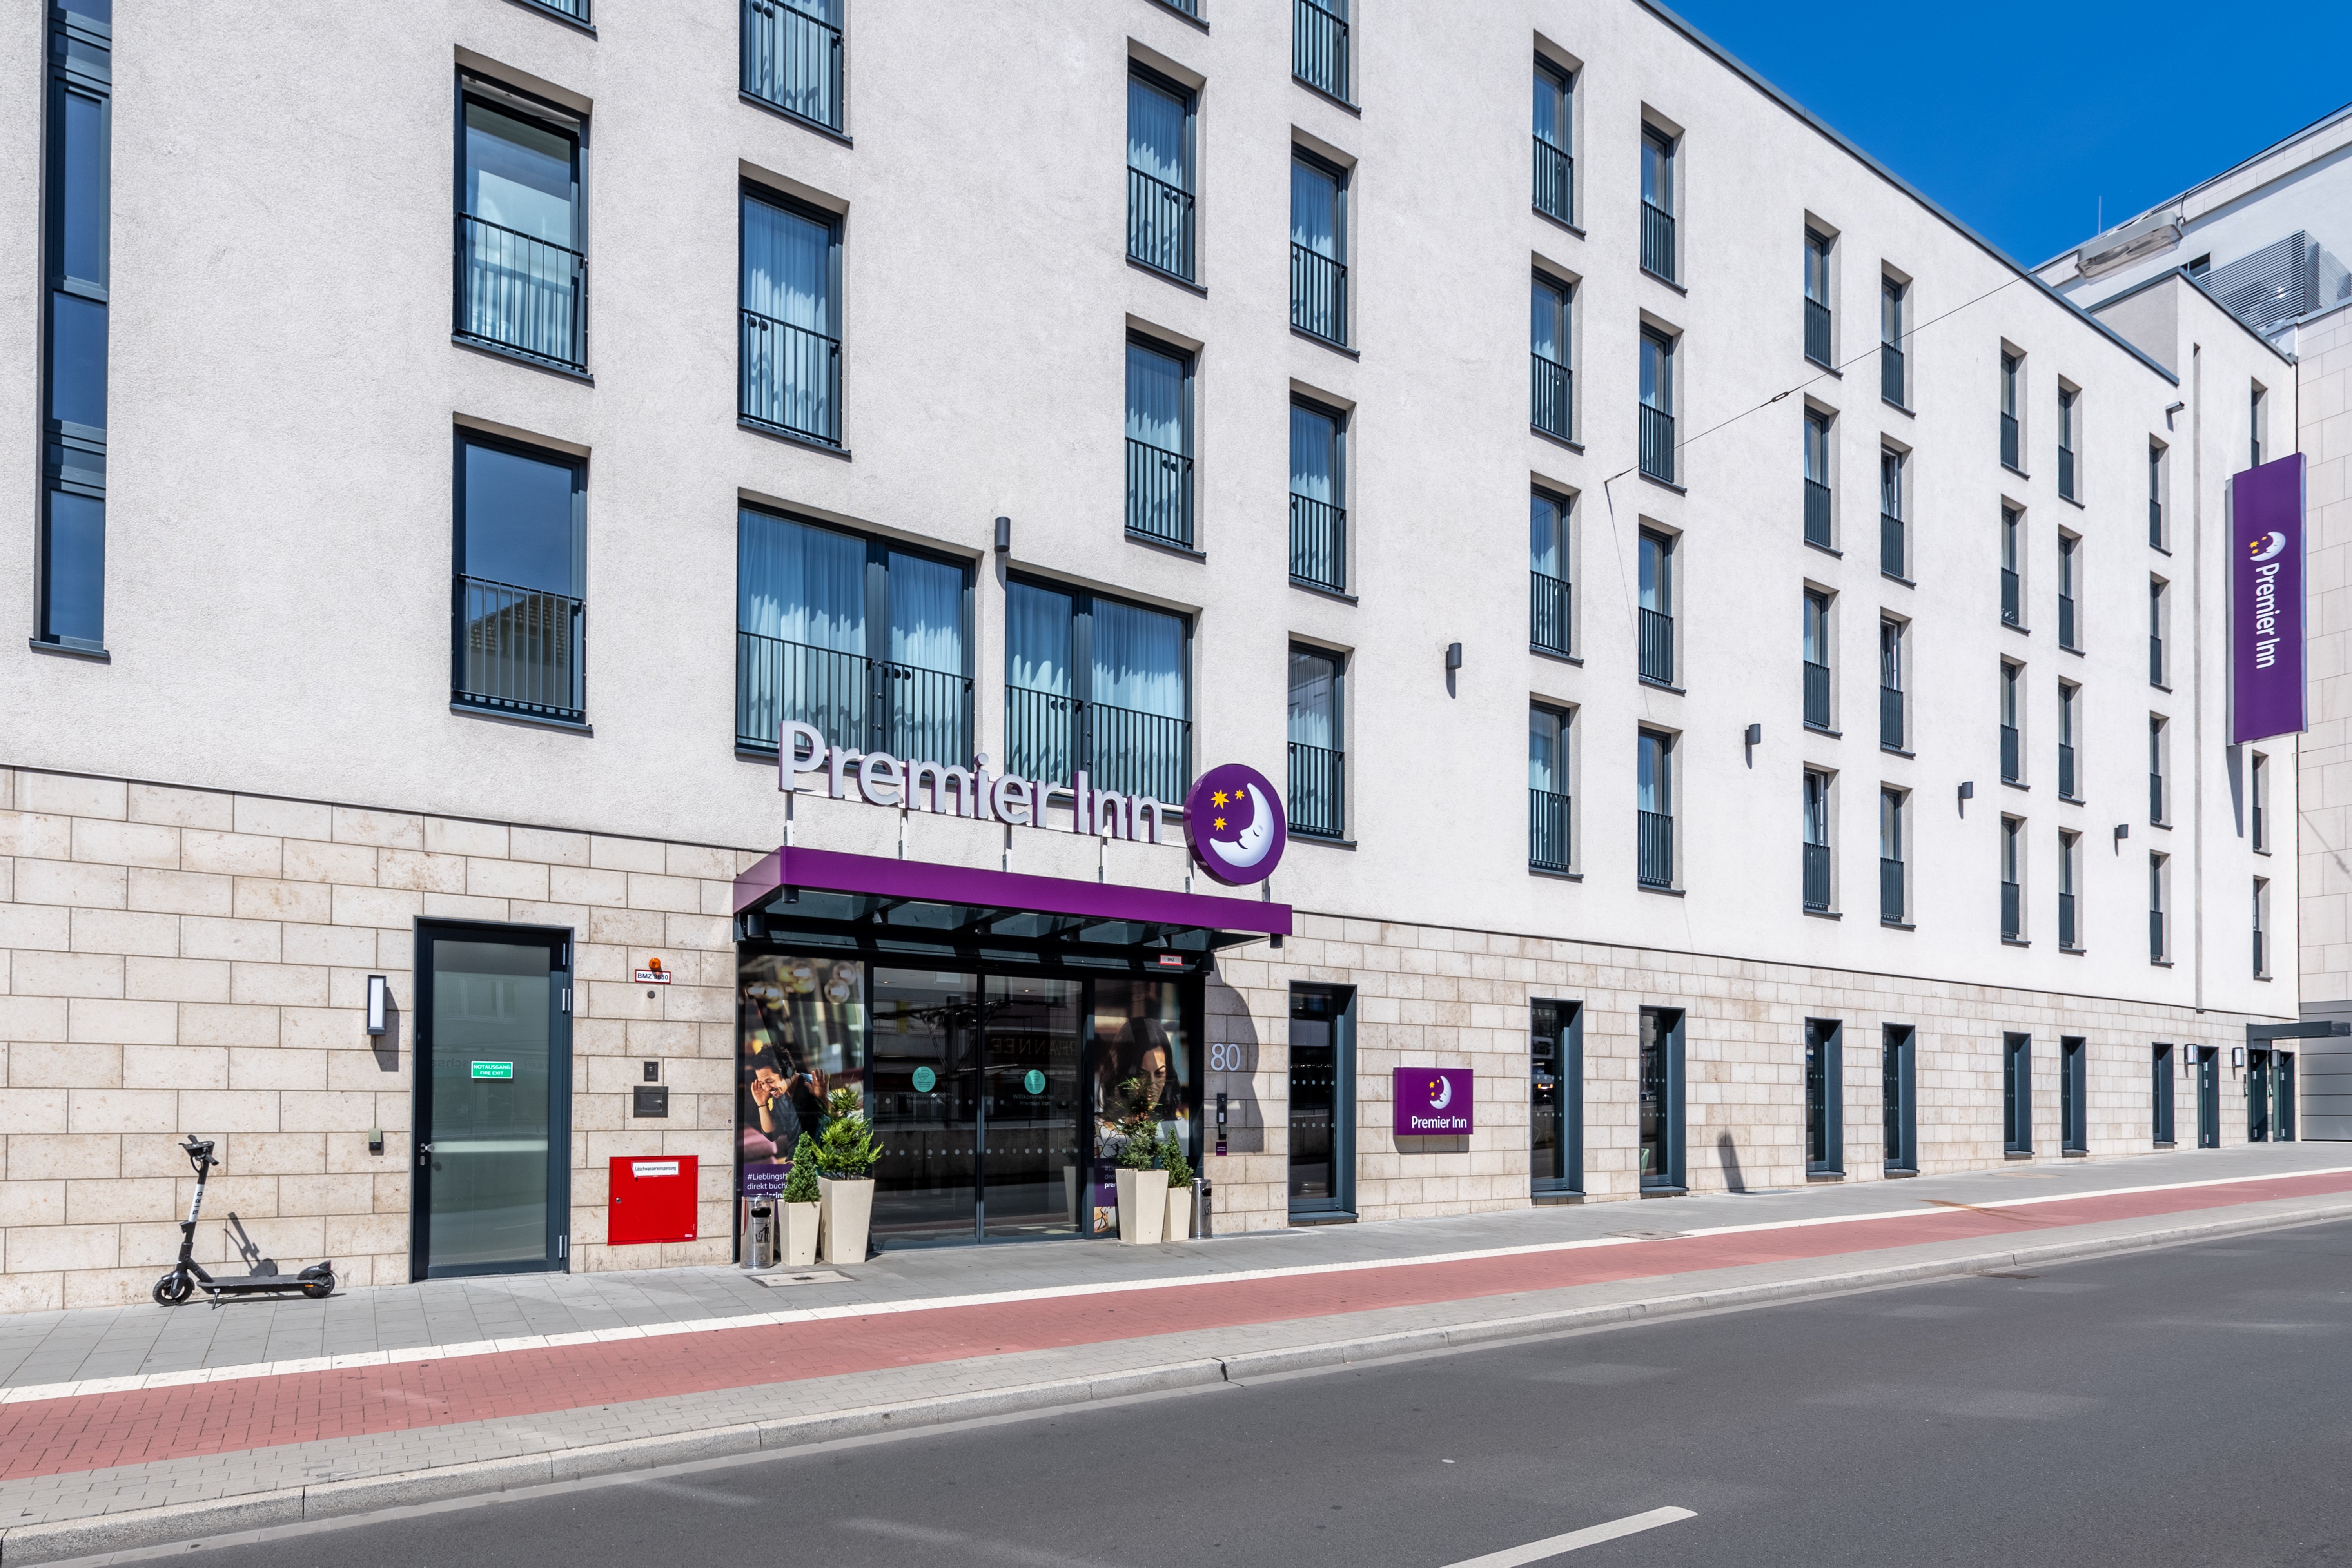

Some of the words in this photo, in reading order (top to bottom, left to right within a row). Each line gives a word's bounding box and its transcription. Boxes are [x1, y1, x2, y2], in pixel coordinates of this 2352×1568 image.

[2256, 563, 2280, 635] Premier
[2256, 637, 2280, 669] Inn
[779, 720, 1060, 828] Premier
[1073, 770, 1162, 844] Inn
[1210, 1043, 1241, 1071] 80
[1412, 1116, 1451, 1129] Premier
[1452, 1116, 1467, 1128] Inn
[747, 1172, 787, 1181] #Lieblingsh
[192, 1191, 203, 1215] BIRD
